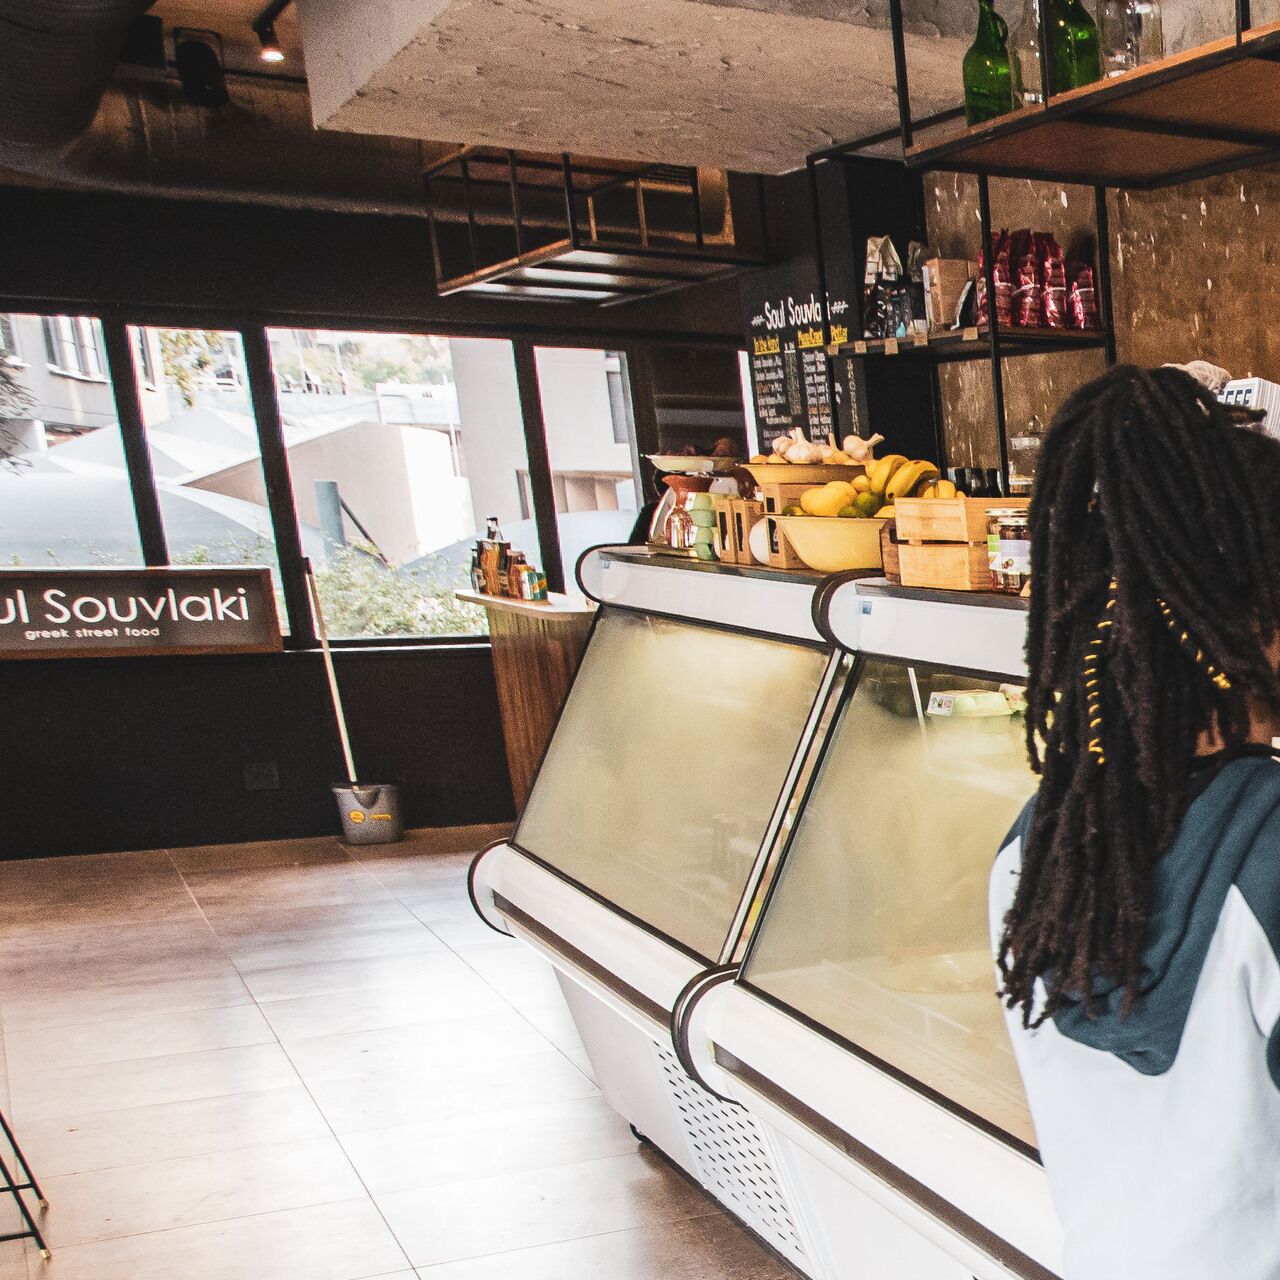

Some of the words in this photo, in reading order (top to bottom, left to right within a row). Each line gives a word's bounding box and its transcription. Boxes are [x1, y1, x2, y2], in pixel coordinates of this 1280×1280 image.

[764, 300, 786, 330] Soul
[788, 292, 831, 326] Souvlai
[43, 587, 250, 624] Souvlaki
[24, 627, 70, 641] greek
[75, 627, 119, 638] street
[124, 627, 161, 638] food
